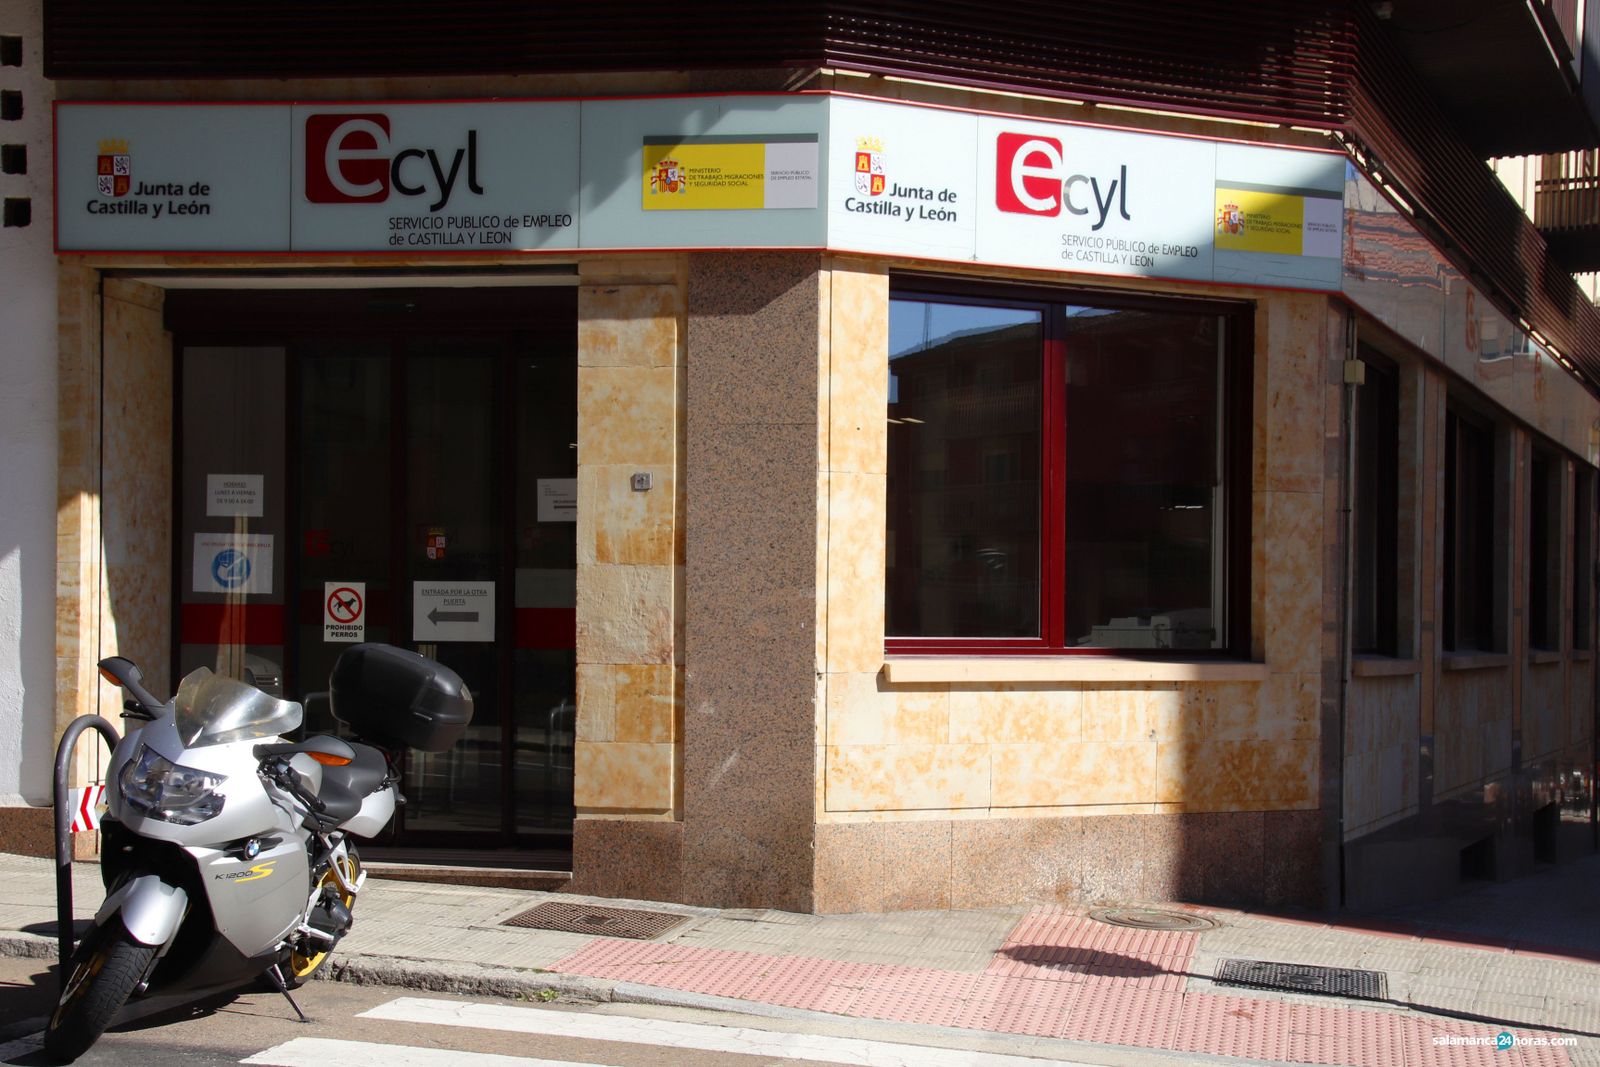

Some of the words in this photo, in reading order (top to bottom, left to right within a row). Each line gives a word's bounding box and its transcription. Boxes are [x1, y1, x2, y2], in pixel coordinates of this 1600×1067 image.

[134, 182, 184, 196] Junta
[188, 181, 210, 196] de
[889, 182, 934, 201] Junta
[938, 187, 957, 203] de
[86, 200, 148, 215] Castilla
[152, 204, 162, 218] y
[168, 200, 210, 215] León
[845, 196, 901, 217] Castilla
[905, 206, 914, 222] y
[919, 203, 957, 222] León
[389, 216, 443, 230] SERVICIO
[503, 216, 519, 228] de
[523, 214, 572, 228] EMPLEO
[389, 233, 404, 245] de
[408, 232, 465, 245] CASTILLA
[468, 232, 475, 244] Y
[1061, 233, 1103, 249] SERVICIO
[1148, 244, 1160, 255] de
[1162, 244, 1198, 258] EMPLEO
[1061, 249, 1073, 260] de
[1076, 249, 1119, 265] CASTILLA
[1121, 254, 1127, 264] Y
